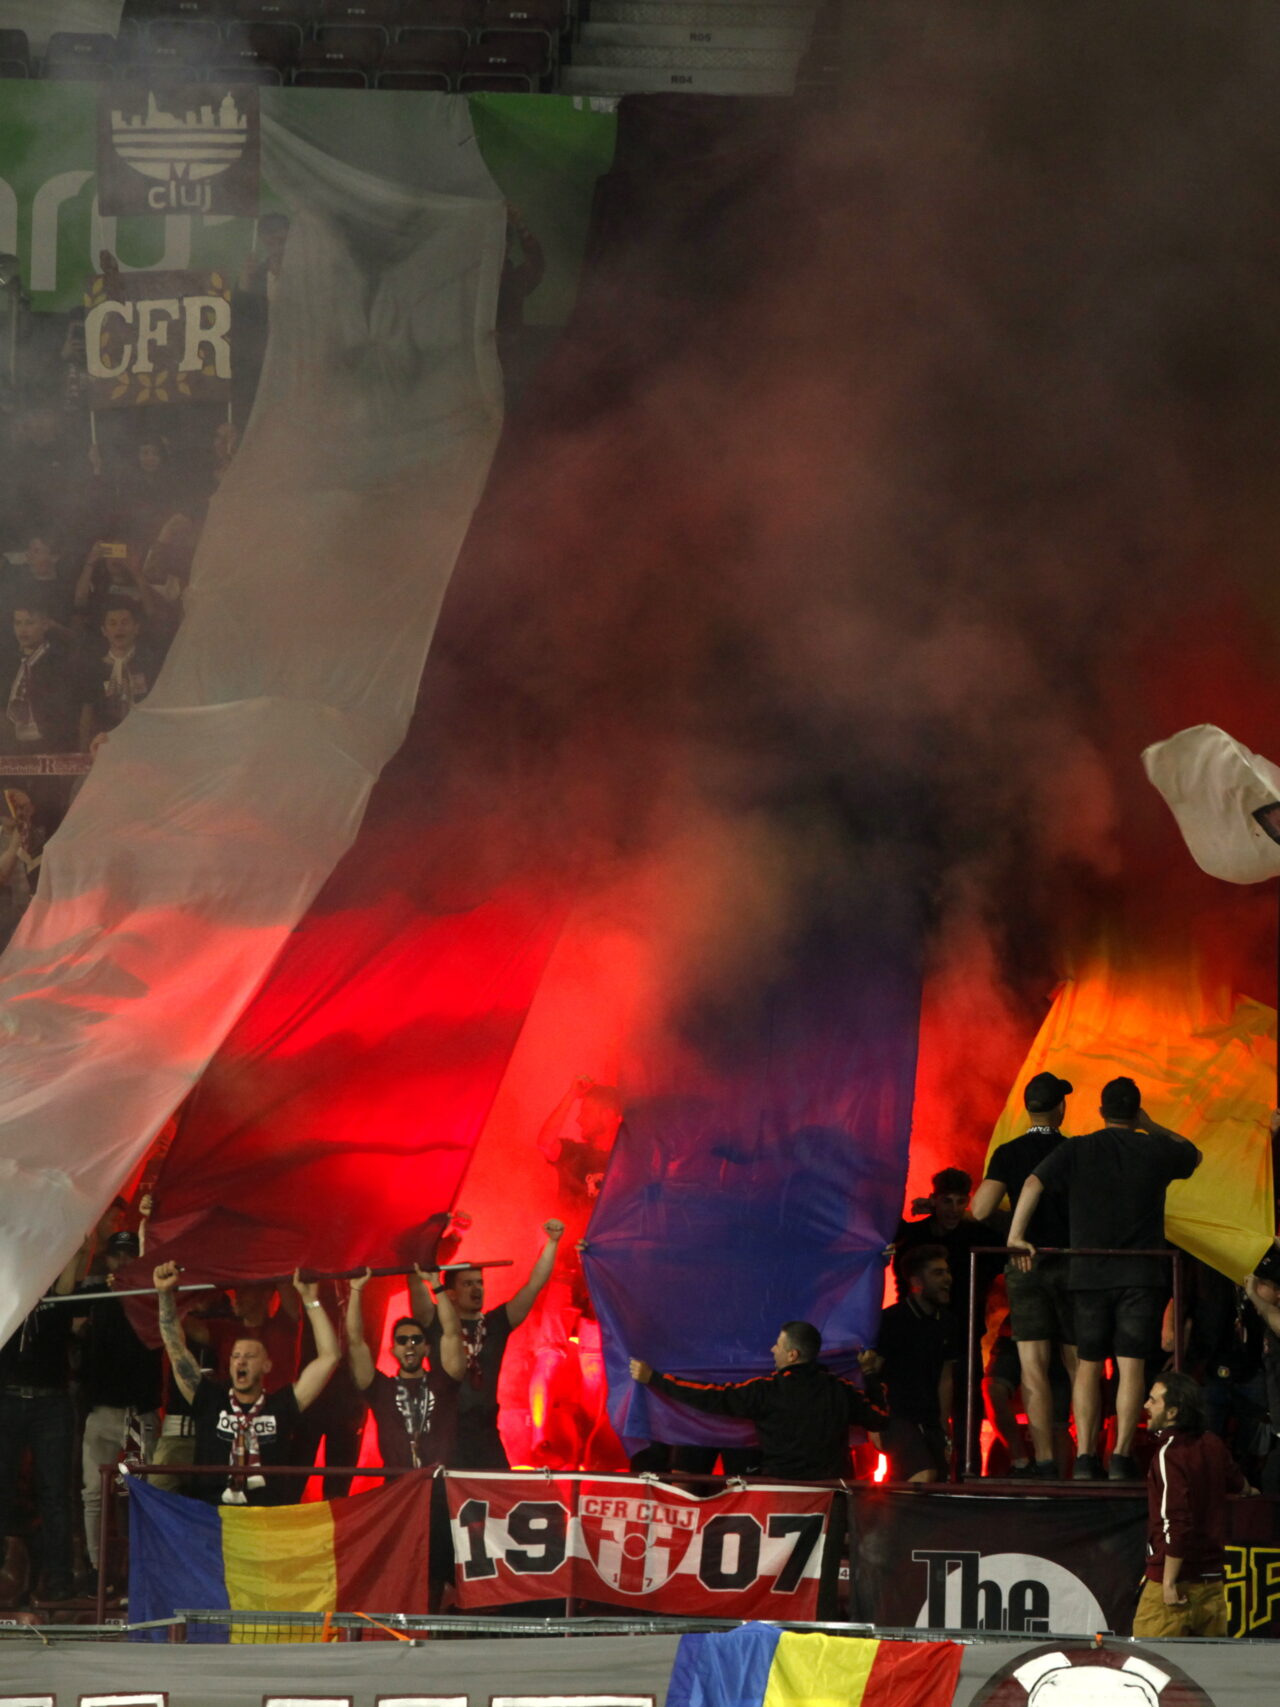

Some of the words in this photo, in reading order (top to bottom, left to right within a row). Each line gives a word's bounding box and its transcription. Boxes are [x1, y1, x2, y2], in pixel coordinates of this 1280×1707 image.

[148, 180, 212, 212] cluj
[84, 295, 232, 379] CFR
[221, 1416, 275, 1433] adas
[583, 1498, 629, 1519] CFR
[636, 1502, 695, 1528] CLUJ
[457, 1499, 571, 1582] 19
[697, 1513, 826, 1594] 07
[911, 1550, 1051, 1633] The
